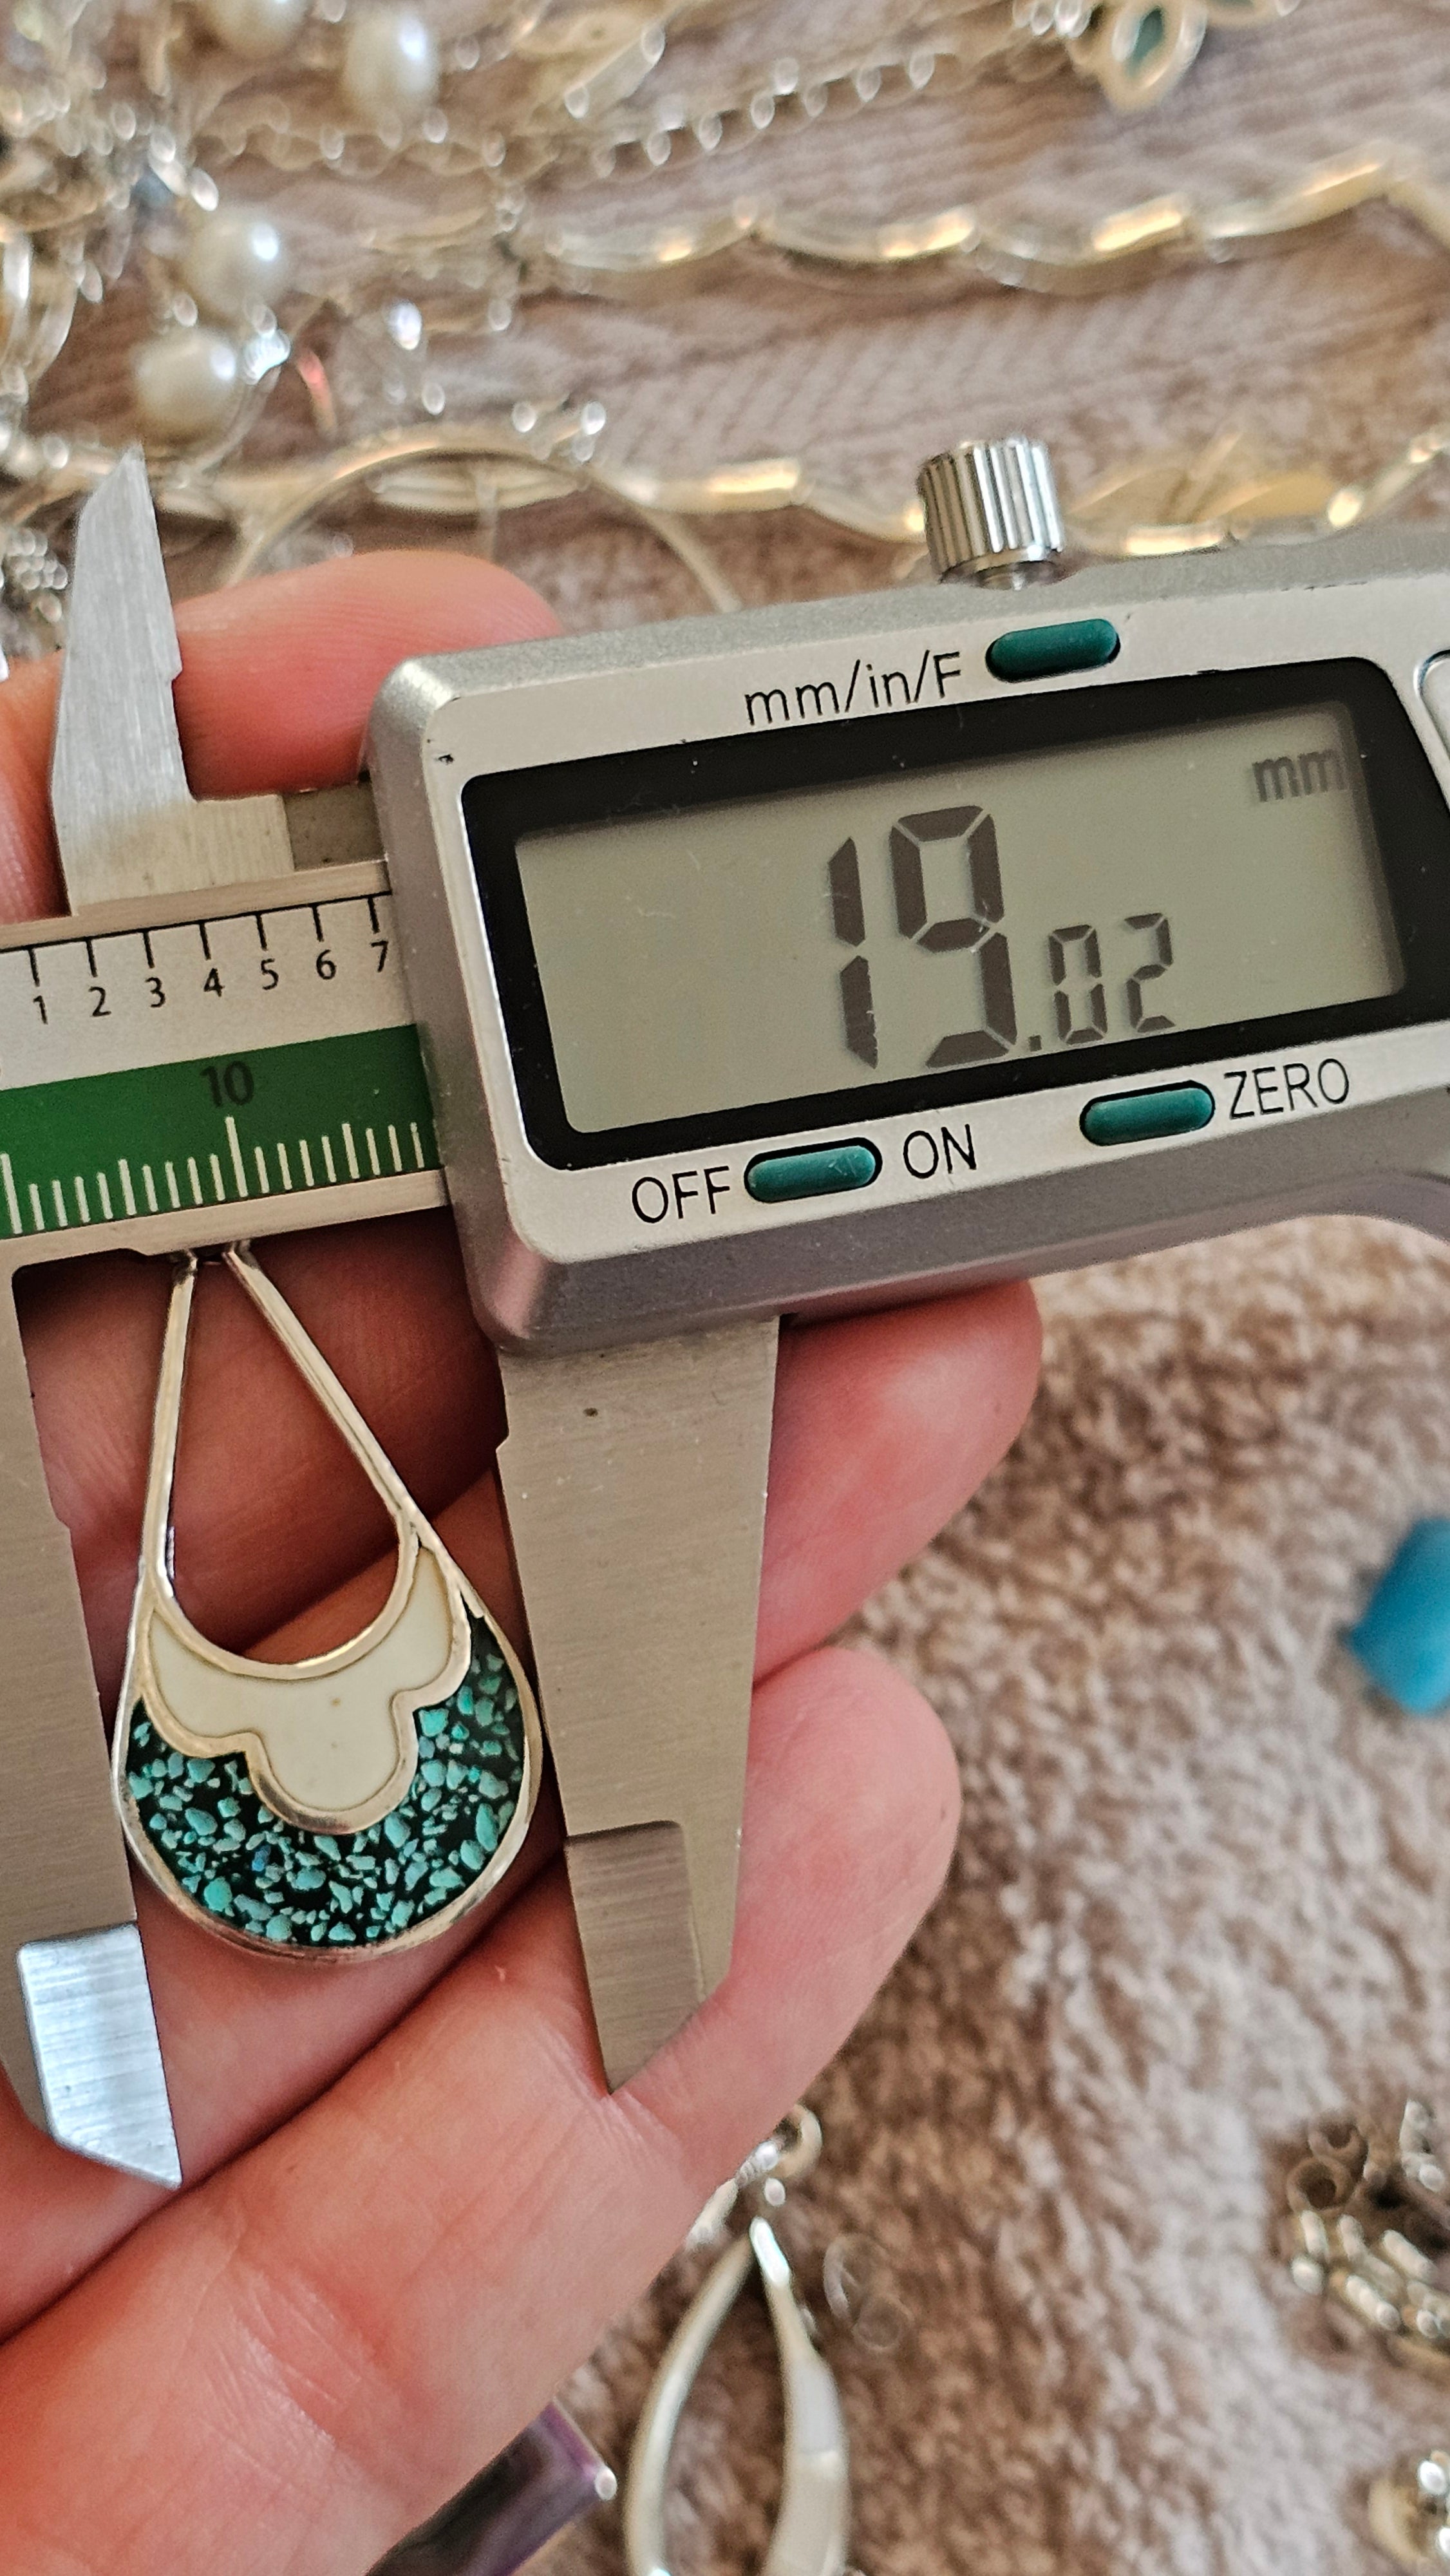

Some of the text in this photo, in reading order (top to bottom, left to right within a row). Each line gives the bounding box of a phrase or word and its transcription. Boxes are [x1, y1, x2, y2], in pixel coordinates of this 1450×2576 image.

[744, 650, 961, 725] mm/in/F
[1252, 748, 1347, 802] mm
[828, 806, 1175, 1069] 19.02
[33, 941, 388, 1025] 1 2 3 4 5 6 7
[200, 1061, 254, 1107] 10
[1223, 1057, 1350, 1122] ZERO
[631, 1123, 977, 1224] OFF ON
